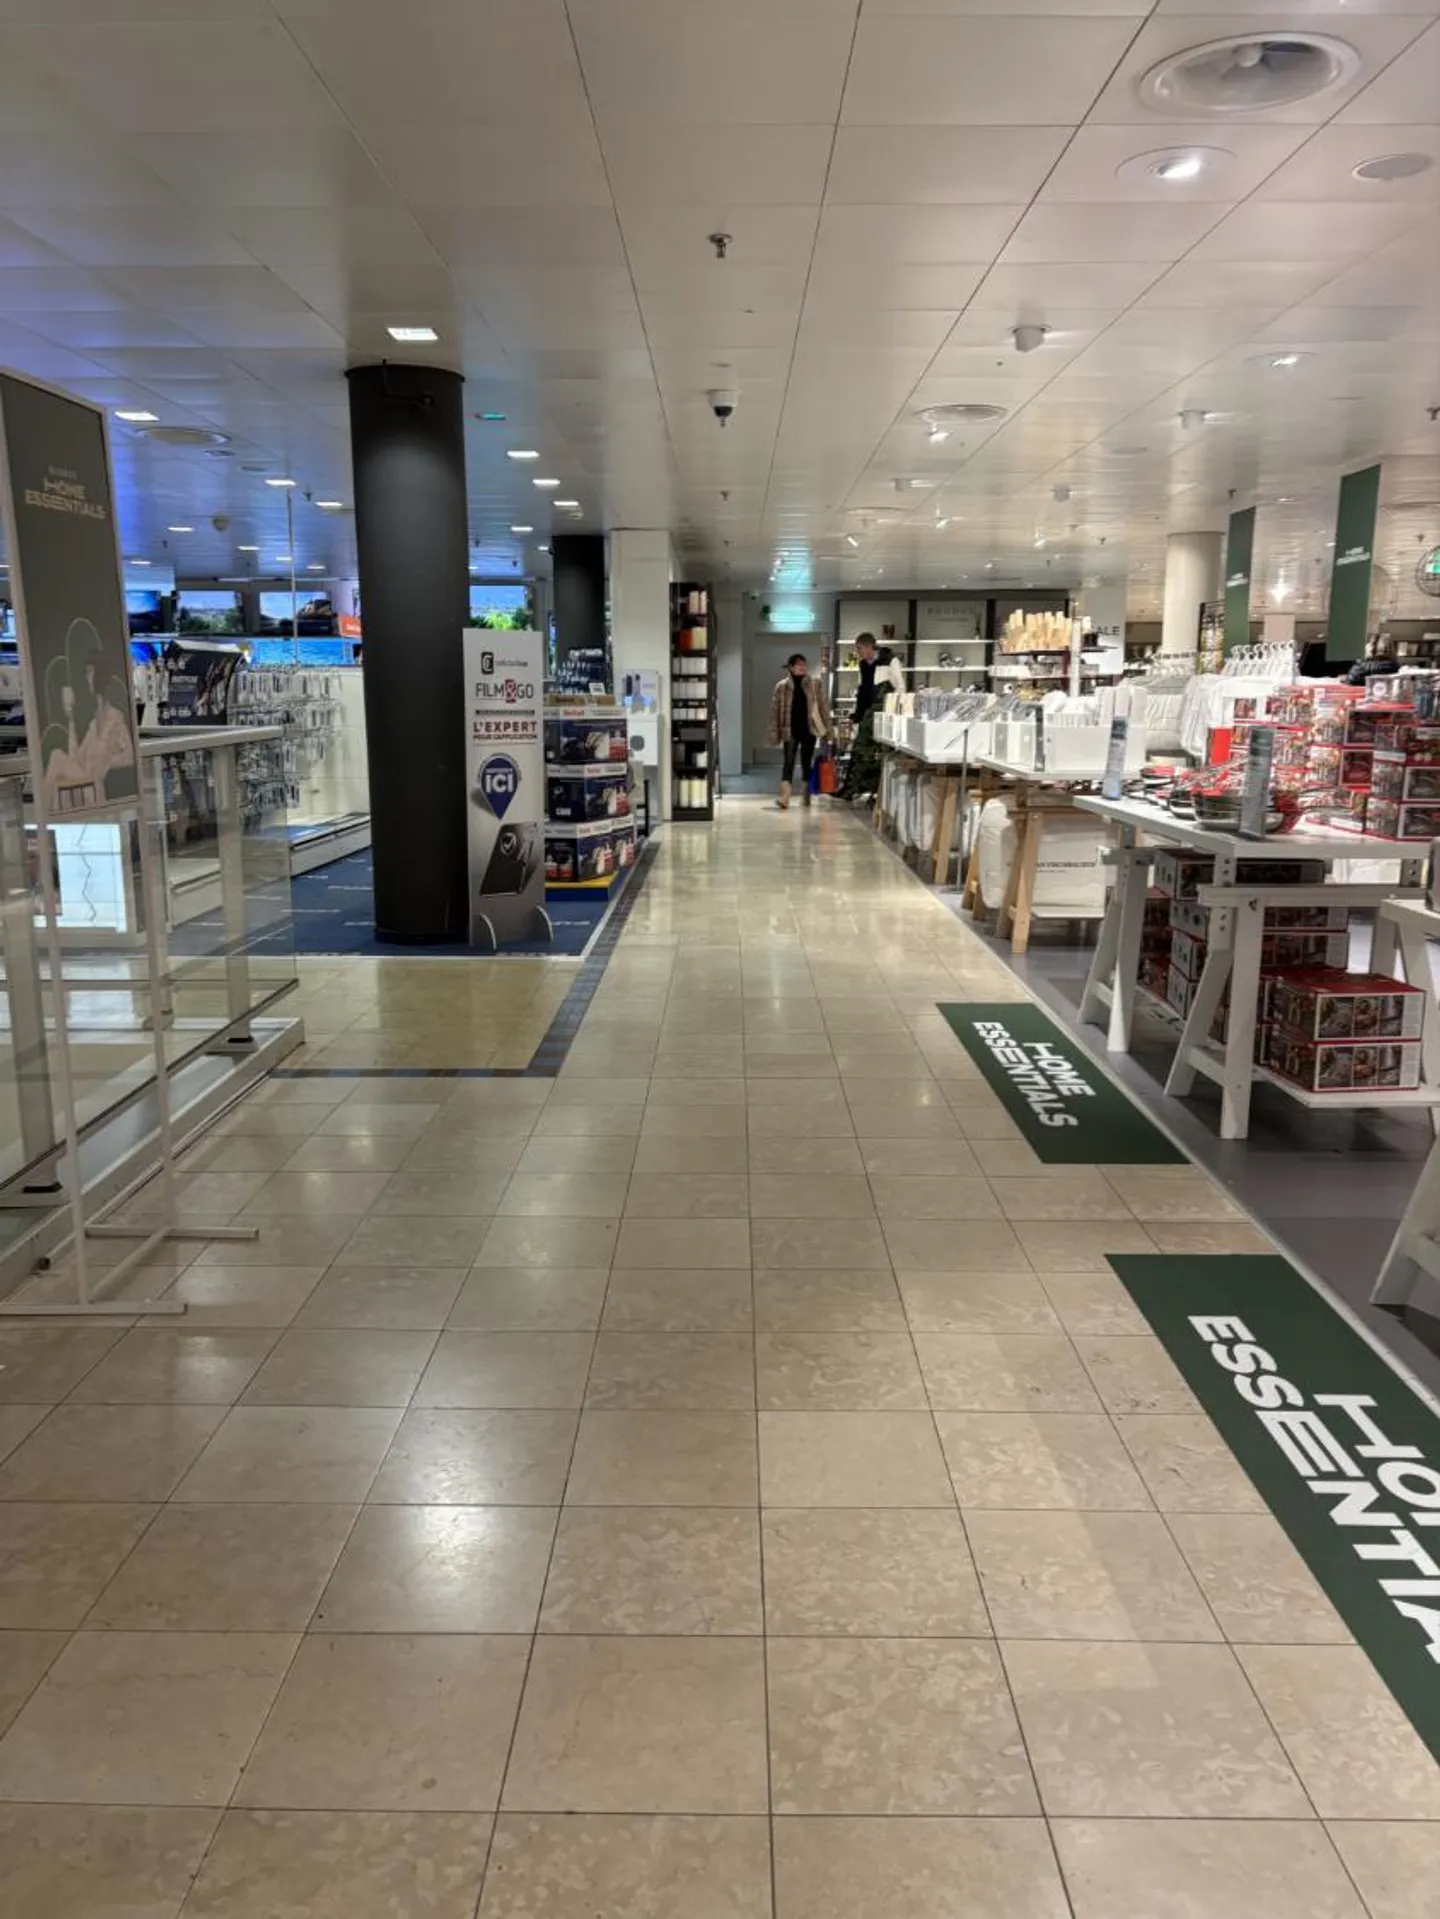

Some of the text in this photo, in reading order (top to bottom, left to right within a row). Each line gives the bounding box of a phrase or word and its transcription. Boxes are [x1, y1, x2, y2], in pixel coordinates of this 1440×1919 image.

[43, 478, 86, 500] HOME
[473, 721, 538, 733] L'EXPERT
[485, 773, 515, 793] ICI
[971, 1021, 1080, 1128] ESSENTIALS
[1022, 1041, 1097, 1097] HOME
